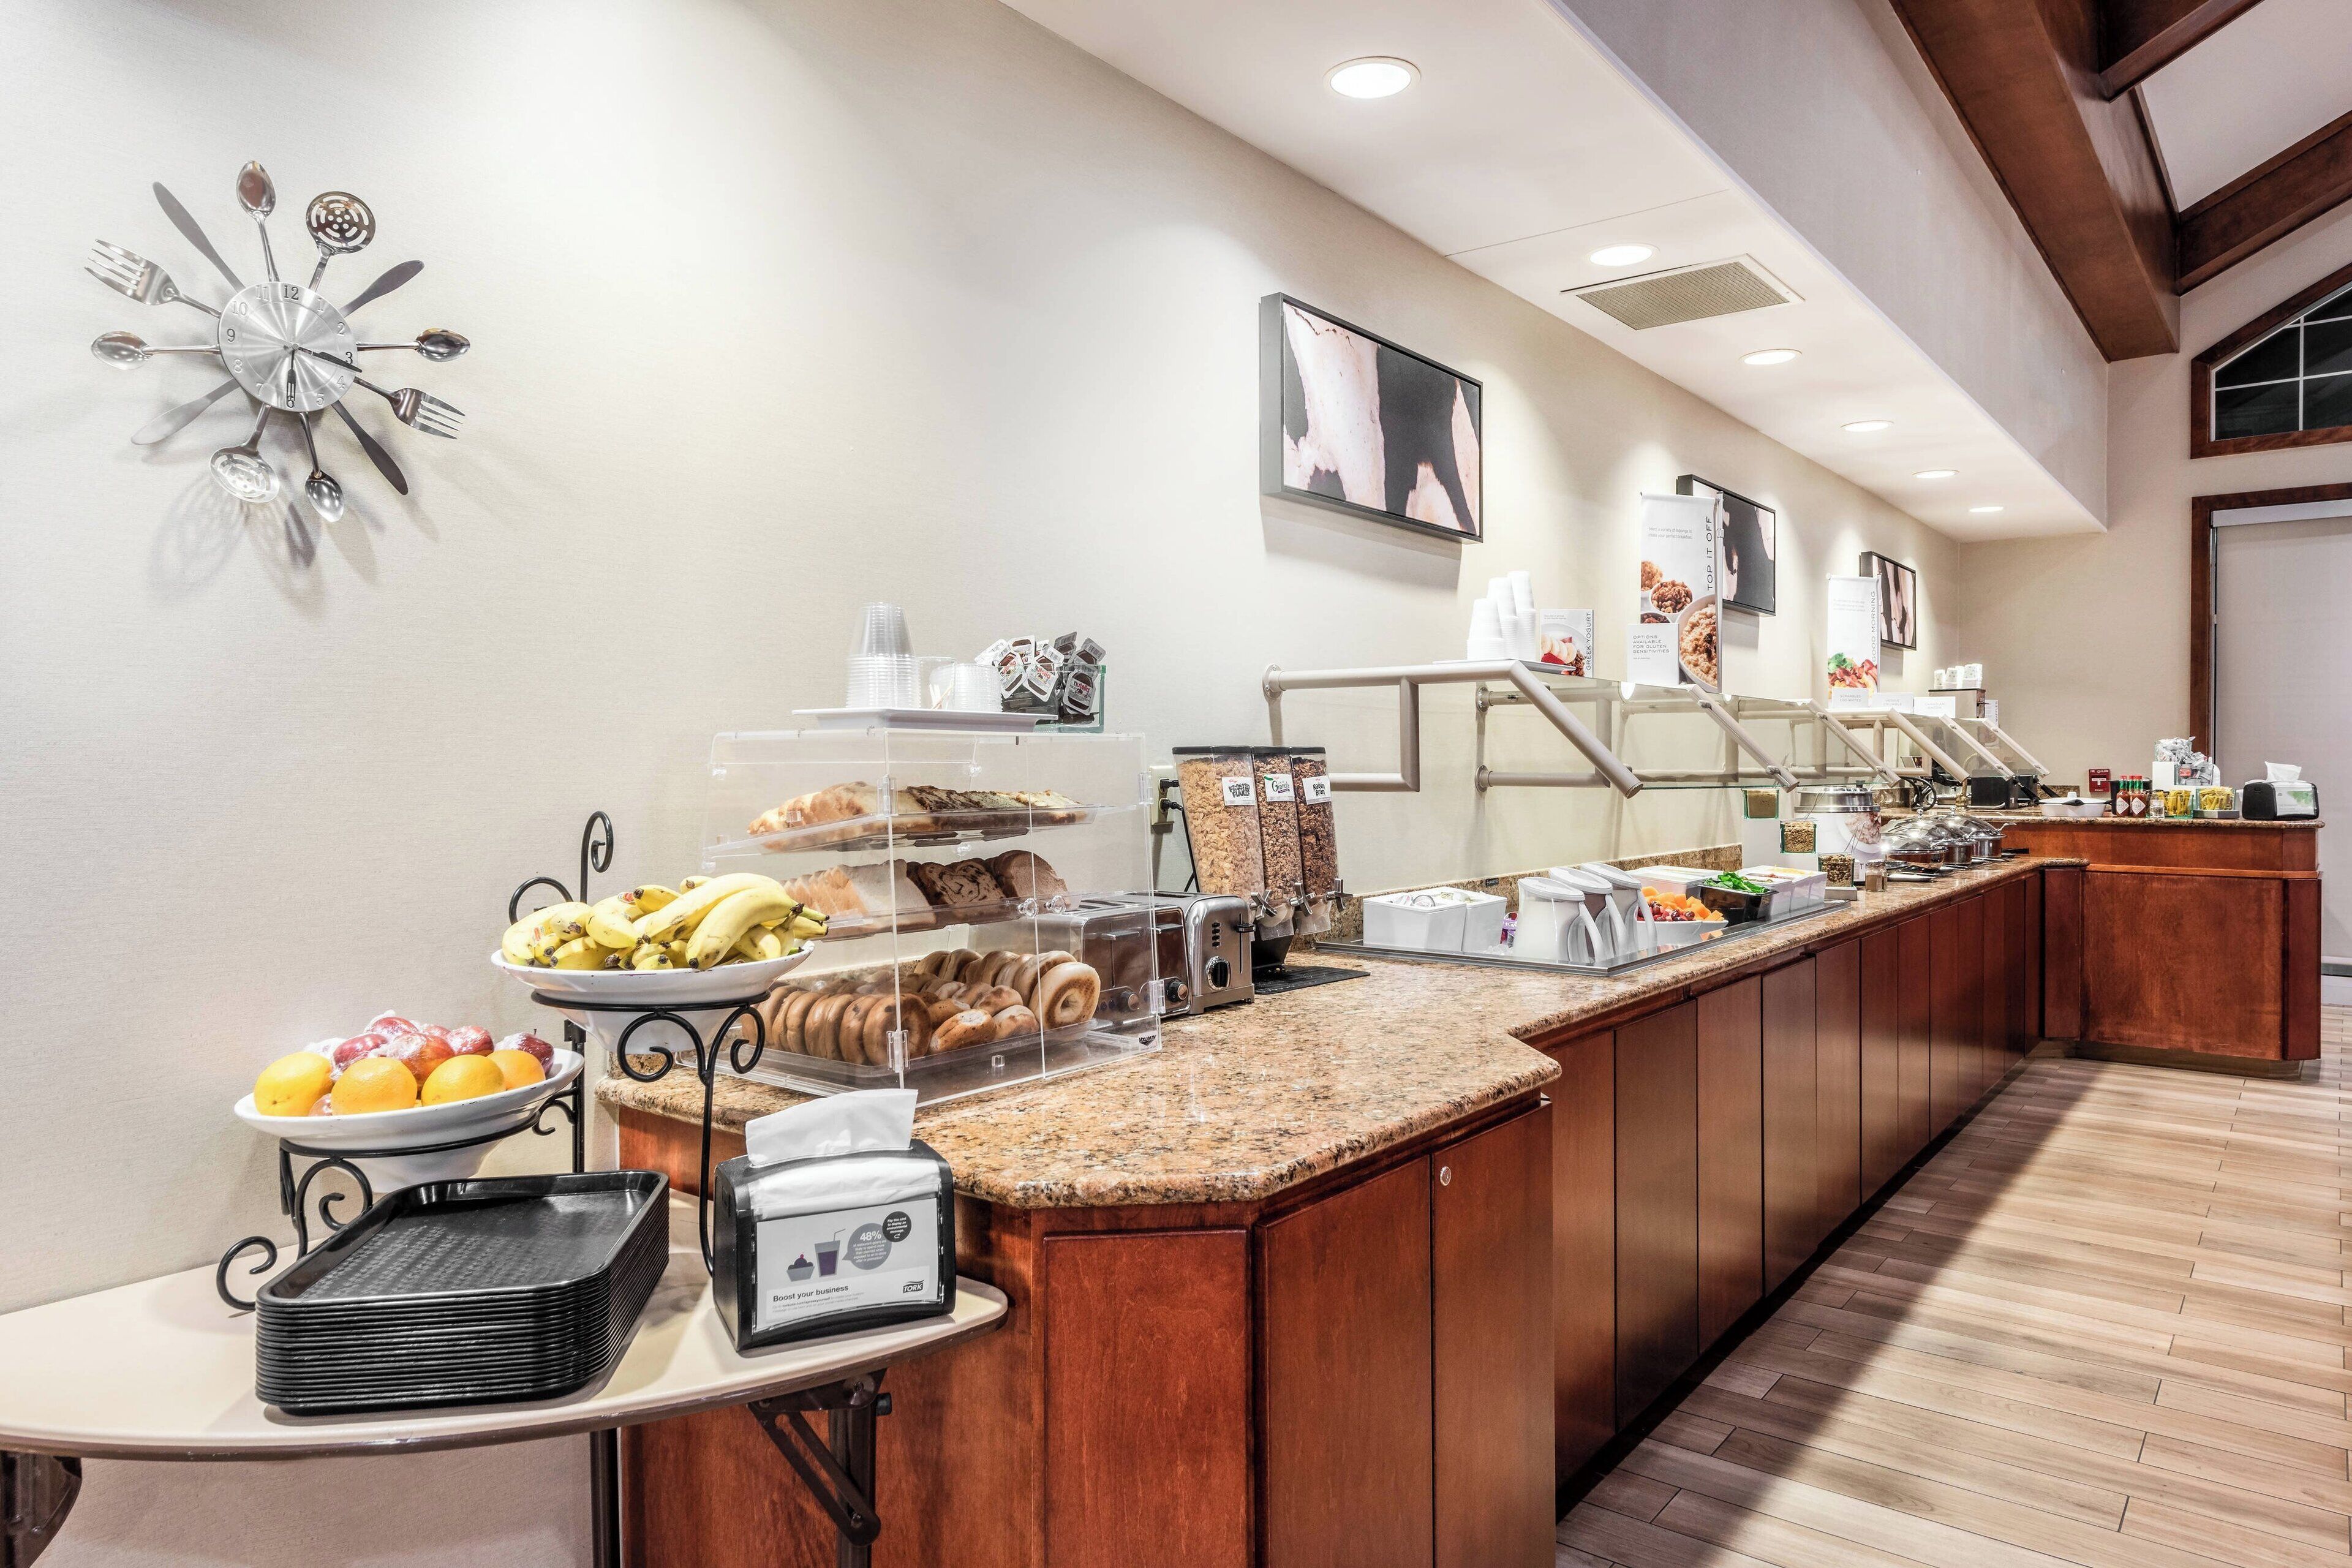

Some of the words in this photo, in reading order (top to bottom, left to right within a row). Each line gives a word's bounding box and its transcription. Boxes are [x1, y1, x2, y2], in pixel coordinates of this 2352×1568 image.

[284, 285, 299, 300] 12
[232, 301, 248, 315] 10
[227, 328, 236, 343] 9
[337, 322, 345, 336] 2
[345, 352, 353, 364] 3
[234, 359, 242, 373] 8
[337, 376, 345, 390] 4
[316, 393, 324, 406] 5
[1706, 548, 1713, 559] IT
[1035, 665, 1051, 679] nutella
[1073, 680, 1091, 693] nutella
[1272, 780, 1290, 792] Granola
[1313, 782, 1325, 791] Raisin
[859, 1230, 882, 1242] 48%
[772, 1293, 796, 1302] Boost
[797, 1291, 814, 1300] your
[815, 1285, 849, 1295] business
[903, 1283, 922, 1292] TORK
